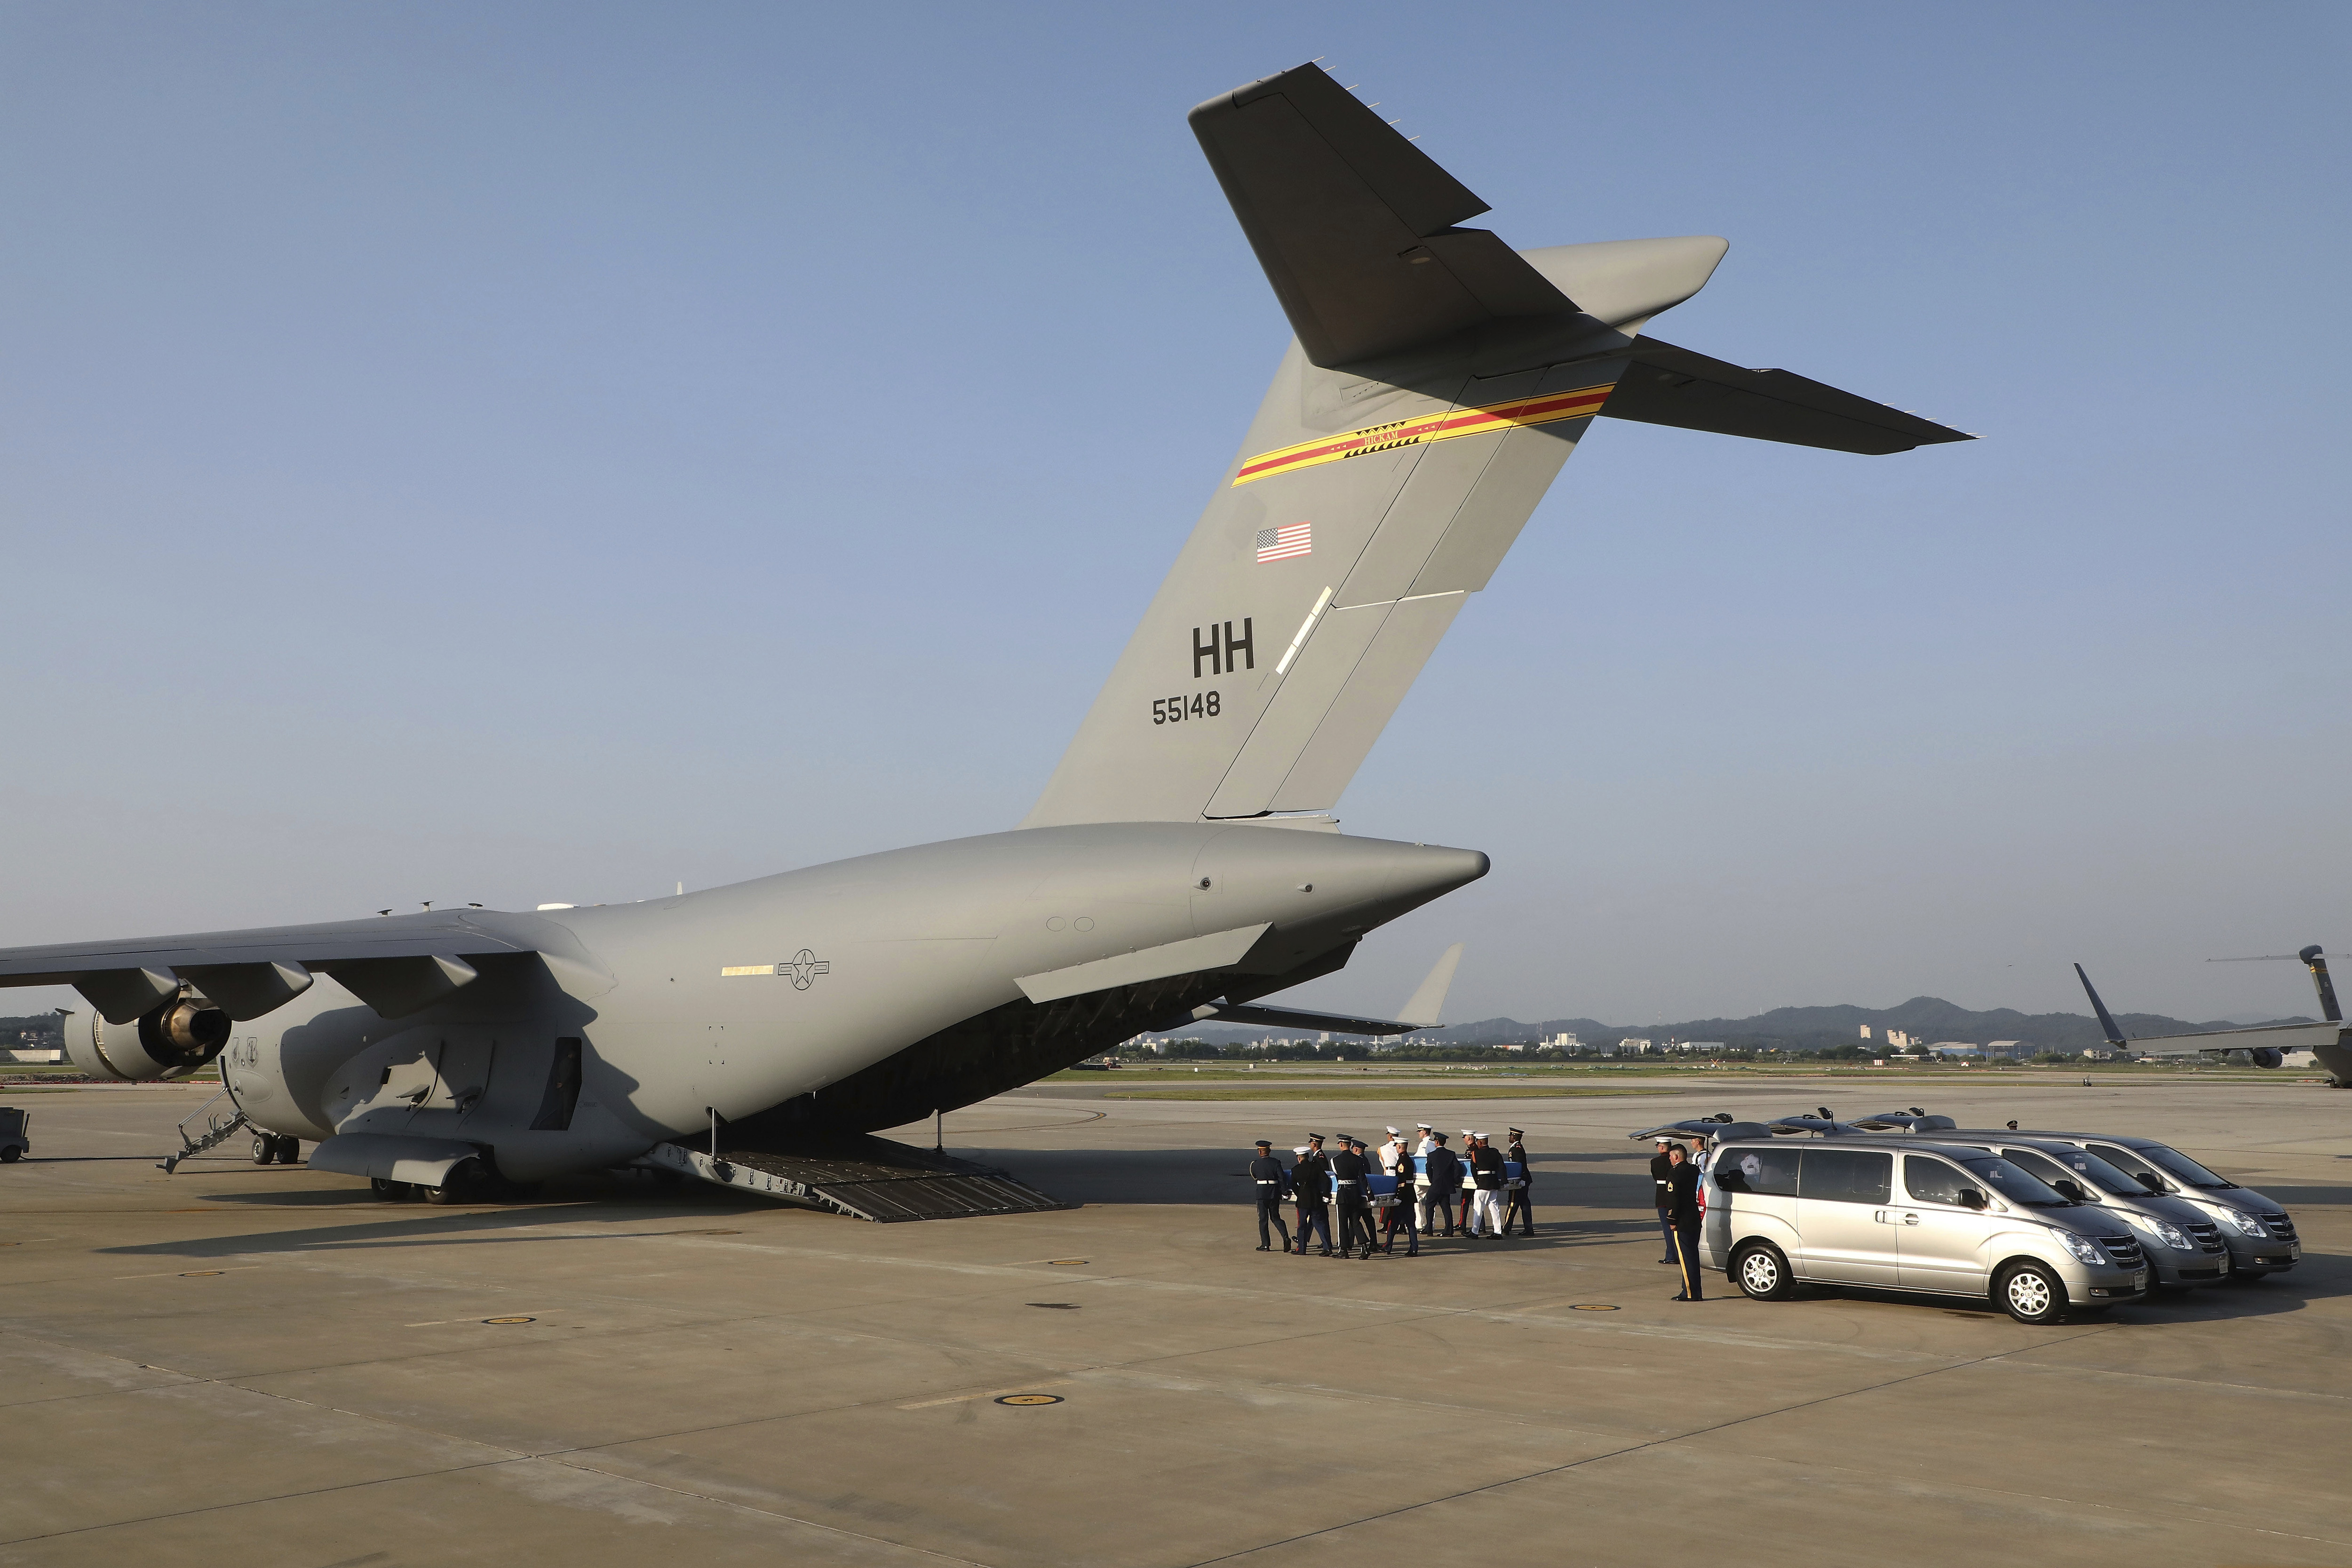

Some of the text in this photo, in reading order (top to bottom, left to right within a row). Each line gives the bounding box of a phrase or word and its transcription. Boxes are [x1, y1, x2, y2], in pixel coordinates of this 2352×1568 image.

[1364, 431, 1398, 446] HICKAM
[1193, 617, 1254, 678] HH
[1153, 690, 1221, 725] 55148
